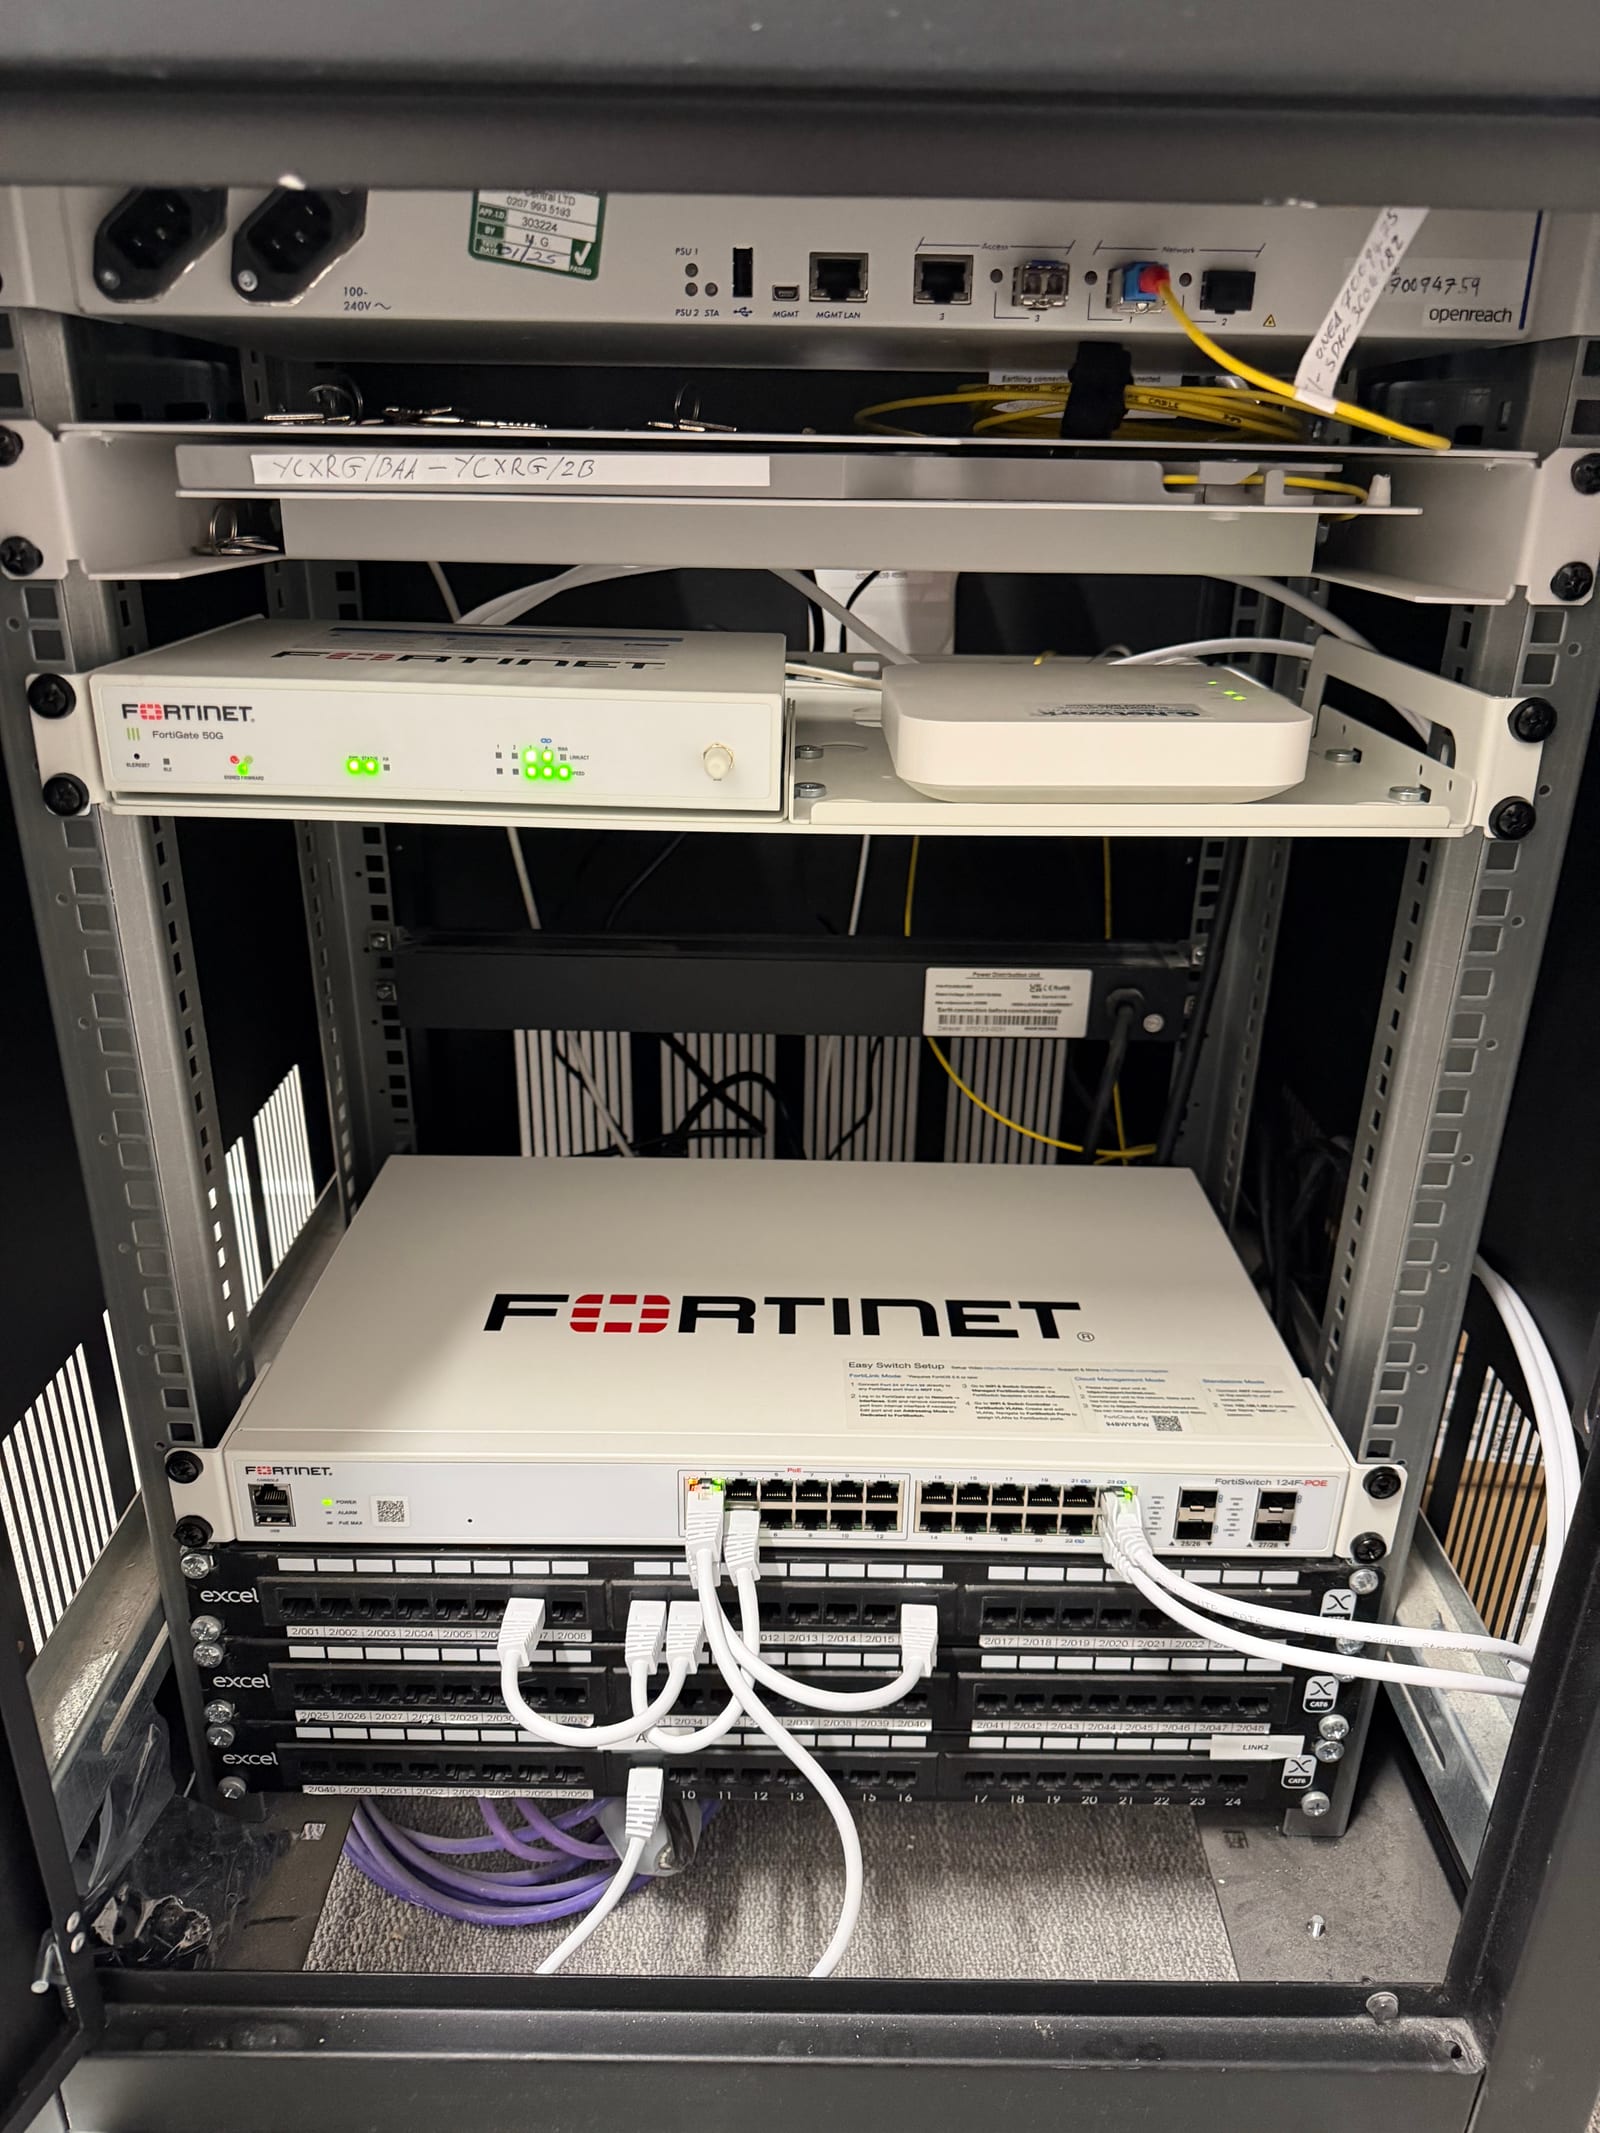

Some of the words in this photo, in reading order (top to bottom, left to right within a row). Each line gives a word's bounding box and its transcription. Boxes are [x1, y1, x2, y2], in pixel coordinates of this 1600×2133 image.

[522, 217, 557, 232] 303224
[675, 248, 693, 256] PSU
[343, 301, 372, 311] 240V
[675, 309, 693, 317] PSU
[704, 309, 720, 317] STA
[773, 310, 799, 318] MGMT
[816, 311, 843, 319] MGMT
[1429, 305, 1512, 324] openreach
[271, 650, 667, 671] FORTINET
[122, 703, 253, 722] FORTINET
[152, 729, 200, 741] FortiGate
[202, 730, 224, 741] 50G
[484, 1292, 1082, 1340] FORTINET
[848, 1361, 873, 1371] Easy
[876, 1361, 911, 1370] Switch
[914, 1362, 945, 1371] Setup
[1098, 1376, 1144, 1384] Management
[245, 1466, 331, 1476] FORTINET
[1215, 1478, 1272, 1486] FortiSwitch
[1276, 1479, 1328, 1487] 124F-POE
[200, 1588, 259, 1603] excel
[291, 1628, 319, 1636] 2/001
[329, 1628, 358, 1636] 2/002
[367, 1629, 397, 1637] 2/003
[405, 1630, 434, 1638] 2/004
[443, 1630, 473, 1638] 2/005
[789, 1634, 818, 1643] 2/013
[827, 1634, 857, 1643] 2/014
[865, 1635, 895, 1643] 2/015
[984, 1637, 1014, 1645] 2/017
[1022, 1638, 1052, 1646] 2/018
[1061, 1638, 1090, 1647] 2/019
[1099, 1639, 1129, 1647] 2/020
[1137, 1639, 1166, 1648] 2/021
[1175, 1640, 1204, 1648] 2/022
[213, 1674, 270, 1689] excel
[1309, 1700, 1329, 1708] CAT6
[301, 1711, 330, 1720] 2/025
[338, 1712, 367, 1720] 2/026
[450, 1714, 478, 1722] 2/029
[487, 1714, 515, 1722] 2/030
[561, 1715, 589, 1724] 2/032
[675, 1718, 704, 1726] 2/034
[899, 1720, 927, 1728] 2/040
[977, 1722, 1005, 1730] 2/041
[1014, 1722, 1042, 1730] 2/042
[1051, 1722, 1080, 1731] 2/043
[1088, 1723, 1117, 1731] 2/044
[1125, 1723, 1154, 1732] 2/045
[1162, 1724, 1191, 1732] 2/046
[1199, 1724, 1228, 1732] 2/047
[1236, 1724, 1265, 1732] 2/048
[1242, 1743, 1270, 1751] LINK2
[222, 1752, 279, 1766] excel
[344, 1786, 372, 1794] 2/050
[681, 1790, 696, 1799] 10
[719, 1791, 732, 1800] 11
[754, 1791, 768, 1800] 12
[790, 1792, 805, 1801] 13
[863, 1793, 877, 1802] 15
[899, 1793, 913, 1802] 16
[974, 1794, 988, 1803] 17
[1011, 1794, 1025, 1804] 18
[1047, 1795, 1061, 1804] 19
[1082, 1796, 1098, 1805] 20
[1119, 1796, 1133, 1805] 21
[1153, 1796, 1170, 1806] 22
[1189, 1796, 1206, 1806] 23
[1225, 1797, 1242, 1806] 24
